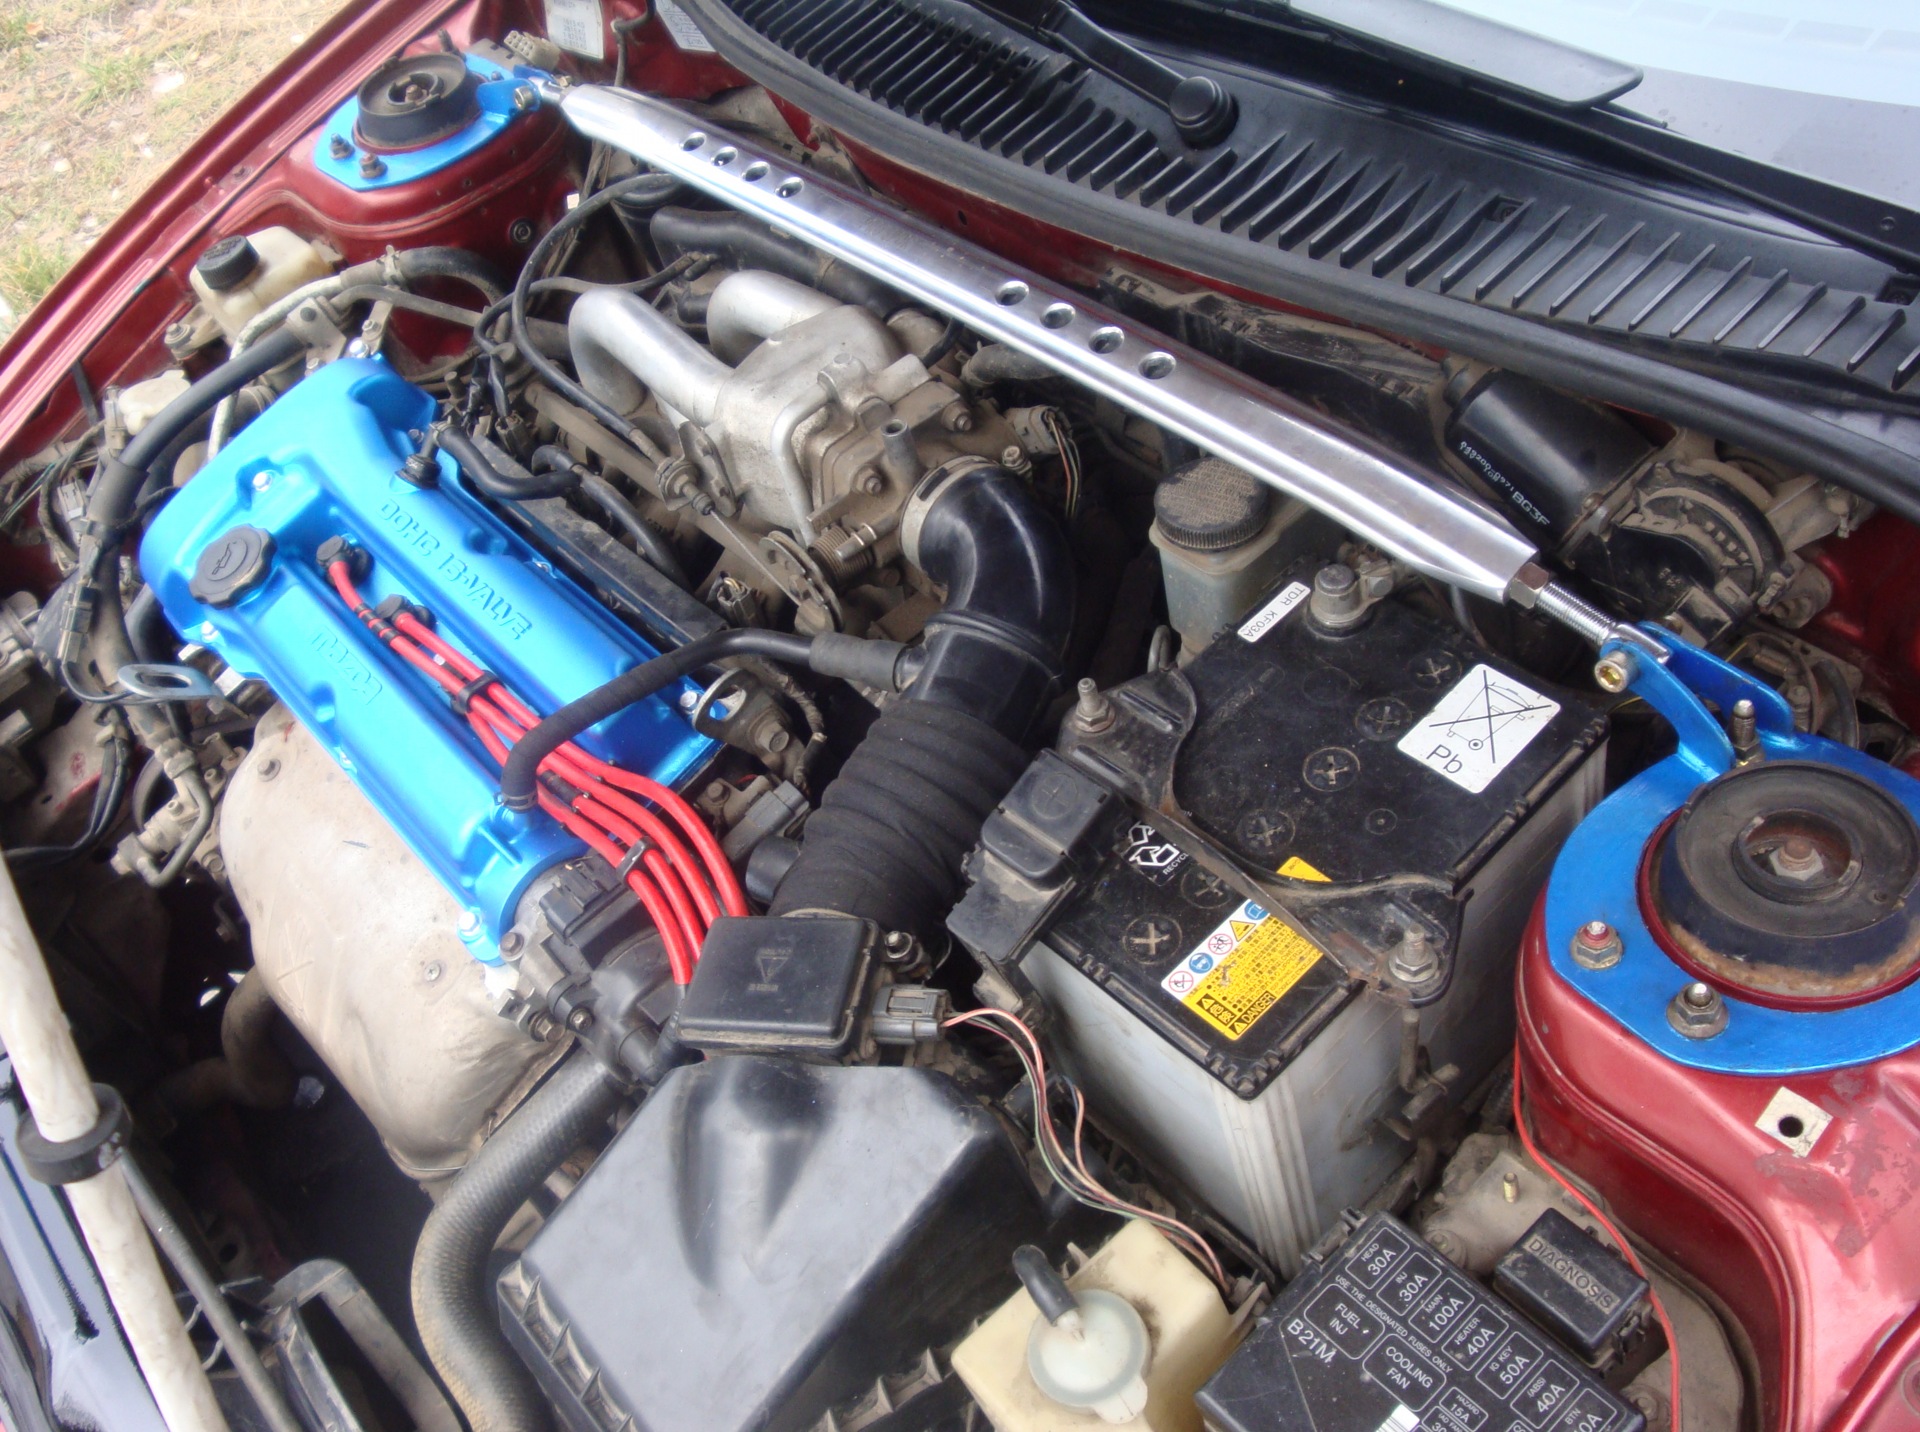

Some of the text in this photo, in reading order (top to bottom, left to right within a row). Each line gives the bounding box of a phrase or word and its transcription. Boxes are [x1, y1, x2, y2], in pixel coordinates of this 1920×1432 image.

[1512, 491, 1550, 525] BG3F
[376, 499, 440, 557] DOHC
[1244, 587, 1306, 638] TDR KF03A
[1426, 744, 1463, 774] Pb
[1241, 992, 1276, 1024] DANGER
[1361, 1242, 1380, 1262] HEAD
[1368, 1249, 1397, 1276] 30A
[1395, 1271, 1408, 1284] INJ
[1399, 1275, 1428, 1301] 30A
[1528, 1239, 1614, 1309] DIAGNOSIS
[1334, 1303, 1361, 1329] FUEL
[1424, 1294, 1444, 1315] MAIN
[1429, 1298, 1464, 1331] 100A
[1329, 1318, 1348, 1335] INJ
[1335, 1275, 1453, 1374] USE THE DESIGNATED FUSES ONLY
[1454, 1317, 1481, 1345] HEATER
[1287, 1318, 1337, 1364] B21M
[1467, 1328, 1495, 1356] 40A
[1385, 1346, 1433, 1389] COOLING
[1489, 1345, 1513, 1372] IG KEY
[1500, 1356, 1530, 1384] 50A
[1386, 1367, 1411, 1389] FAN
[1456, 1394, 1480, 1415] HAZARD
[1536, 1384, 1565, 1413] 40A
[1450, 1403, 1470, 1423] 15A
[1564, 1407, 1581, 1425] BTN
[1573, 1413, 1602, 1432] 0A
